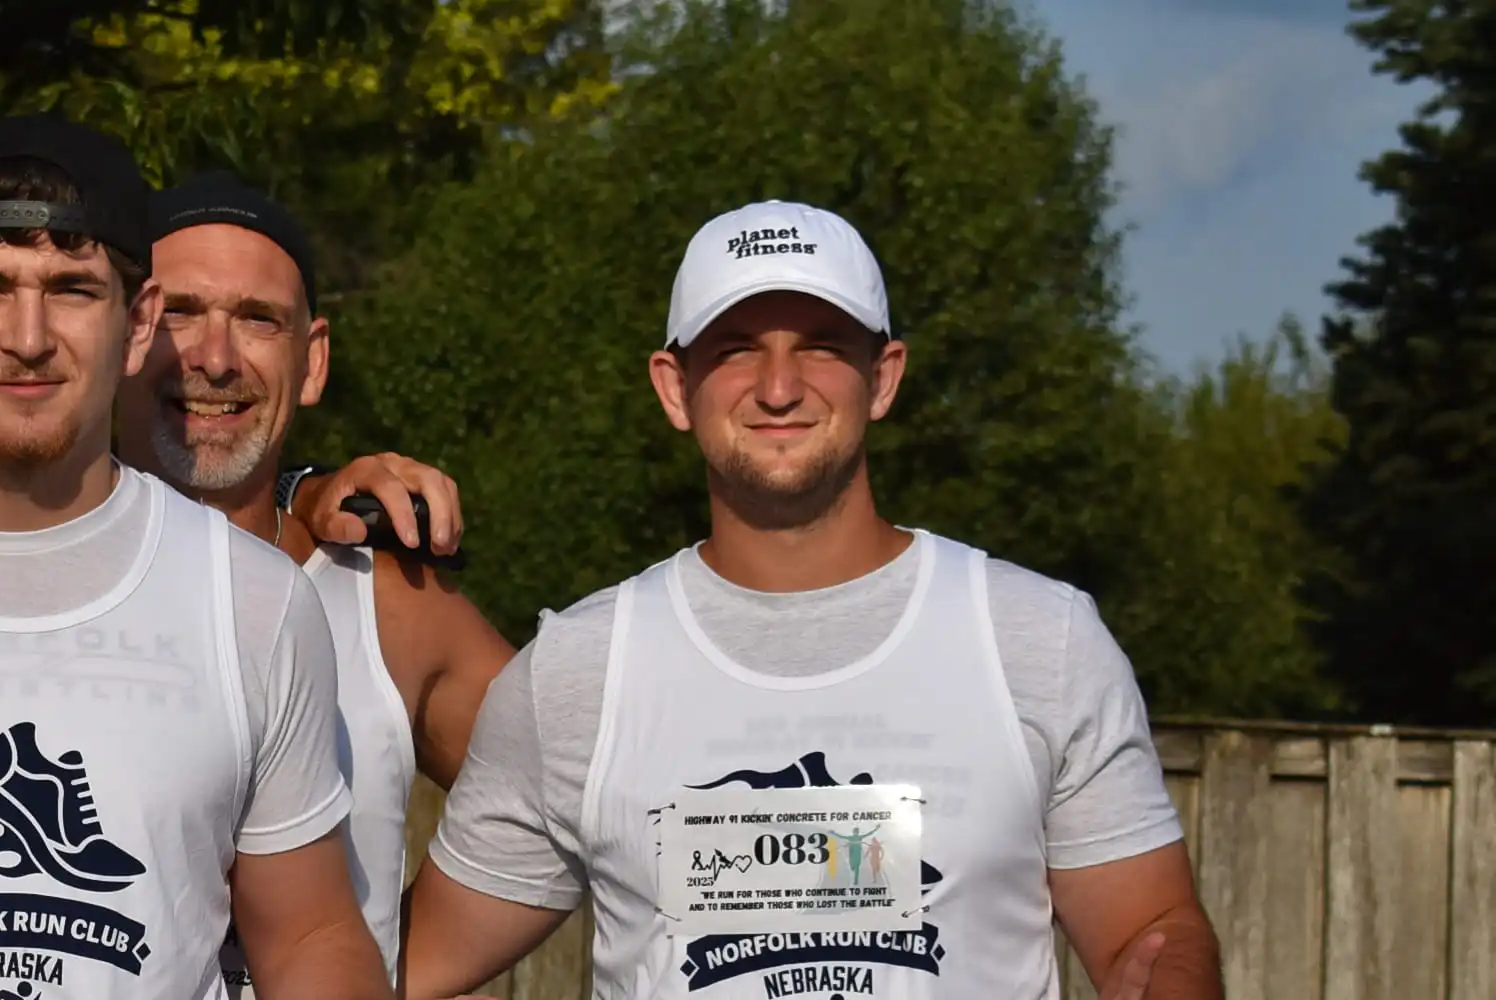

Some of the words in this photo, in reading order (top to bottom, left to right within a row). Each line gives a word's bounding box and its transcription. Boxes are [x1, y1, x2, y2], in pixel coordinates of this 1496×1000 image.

[726, 227, 800, 253] planet
[735, 243, 817, 259] fitness
[685, 815, 724, 825] HIGHWAY
[729, 815, 738, 824] 91
[777, 813, 827, 822] CONCRETE
[831, 812, 849, 821] FOR
[852, 811, 892, 820] CANCER
[754, 833, 829, 865] 083
[687, 877, 714, 887] 2025
[718, 891, 734, 899] RUN
[737, 890, 753, 898] FOR
[756, 890, 781, 898] THOSE
[785, 889, 803, 897] WHO
[806, 888, 846, 896] CONTINUE
[863, 887, 887, 895] FIGHT
[689, 903, 705, 911] AND
[720, 902, 764, 910] REMEMBER
[768, 901, 793, 909] THOSE
[796, 901, 814, 909] WHO
[817, 900, 837, 908] LOST
[13, 912, 63, 936] RUN
[71, 922, 130, 953] CLUB
[706, 932, 815, 969] NORFOLK
[821, 932, 872, 947] RUN
[876, 931, 927, 956] CLUB
[764, 966, 873, 999] NEBRASKA
